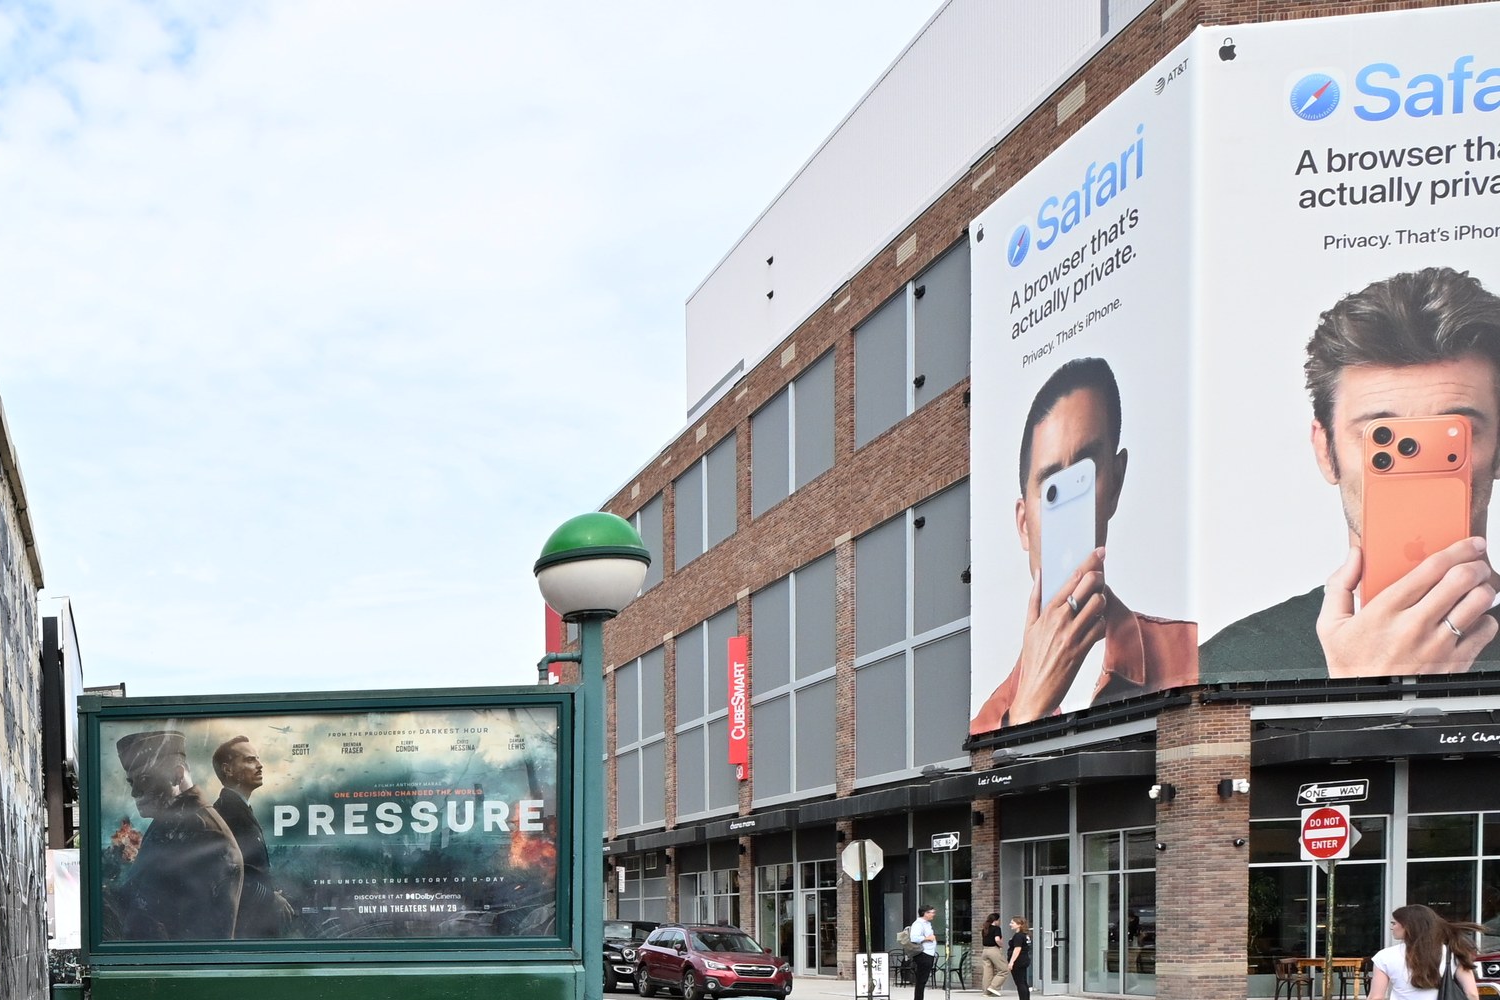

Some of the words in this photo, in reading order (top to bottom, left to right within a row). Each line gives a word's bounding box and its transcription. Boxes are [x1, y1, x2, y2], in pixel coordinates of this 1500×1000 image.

[1166, 57, 1190, 85] AT&T
[1294, 149, 1319, 176] A
[1326, 143, 1457, 173] browser
[1463, 136, 1500, 162] th
[1036, 123, 1145, 250] Safari
[1298, 176, 1423, 209] actually
[1323, 233, 1392, 250] Privacy.
[1395, 227, 1450, 245] That's
[1009, 290, 1021, 314] A
[1023, 243, 1087, 303] browser
[1090, 207, 1139, 256] that's
[1011, 288, 1069, 340] actually
[1073, 242, 1137, 302] private.
[1022, 339, 1055, 368] Privacy.
[1056, 321, 1083, 348] That's
[1085, 297, 1122, 329] iPhone.
[419, 727, 460, 735] DARKEST
[291, 748, 310, 756] SCOTT
[341, 746, 364, 755] FRASER
[395, 745, 419, 753] CONDON
[450, 744, 476, 752] MESSINA
[508, 743, 526, 751] LEWIS
[334, 791, 350, 799] ONE
[353, 790, 392, 798] DECISION
[395, 789, 434, 797] CHANGED
[436, 788, 452, 796] THE
[454, 788, 484, 796] WORLD
[1305, 788, 1328, 799] ONE
[1339, 786, 1361, 796] WAY
[273, 799, 545, 837] PRESSURE
[1309, 817, 1322, 827] DO
[1323, 816, 1340, 826] NOT
[1311, 839, 1338, 850] ENTER
[415, 892, 434, 901] Dolby
[434, 892, 462, 900] Cinema
[358, 905, 377, 914] ONLY
[379, 904, 387, 913] IN
[388, 904, 428, 913] THEATERS
[430, 904, 445, 913] MAY
[447, 904, 457, 912] 29
